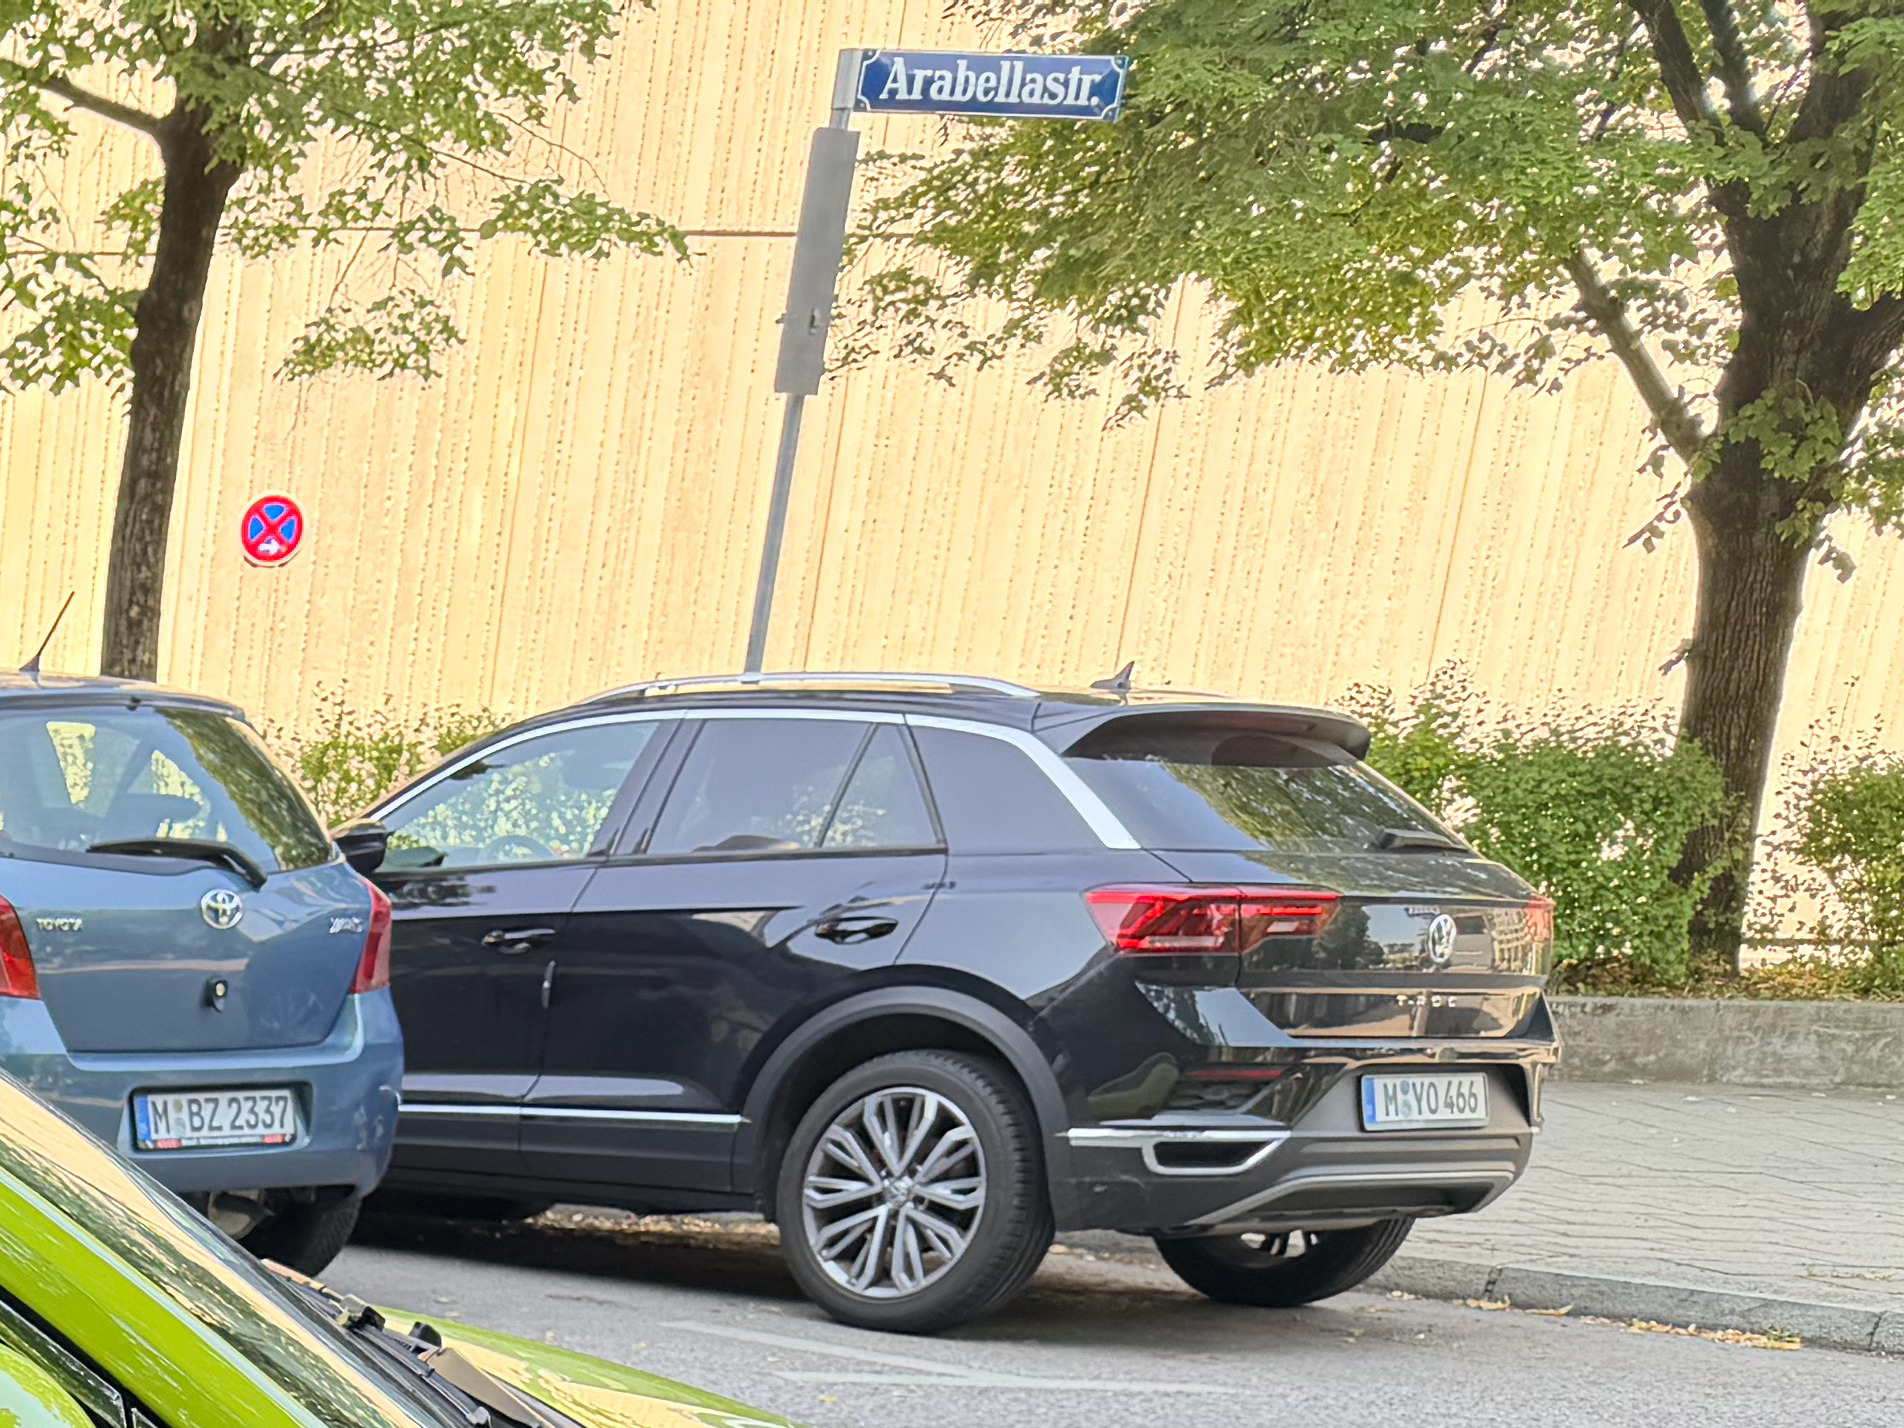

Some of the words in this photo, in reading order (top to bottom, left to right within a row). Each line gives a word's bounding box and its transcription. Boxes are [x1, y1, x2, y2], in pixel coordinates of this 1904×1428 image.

[879, 57, 1104, 106] Arabellastr.
[37, 918, 84, 931] TOYOTA
[151, 1100, 171, 1135] M
[187, 1098, 223, 1133] BZ
[227, 1095, 289, 1130] 2337
[1383, 1082, 1400, 1117] M
[1412, 1081, 1439, 1116] YO
[1443, 1080, 1479, 1114] 466
